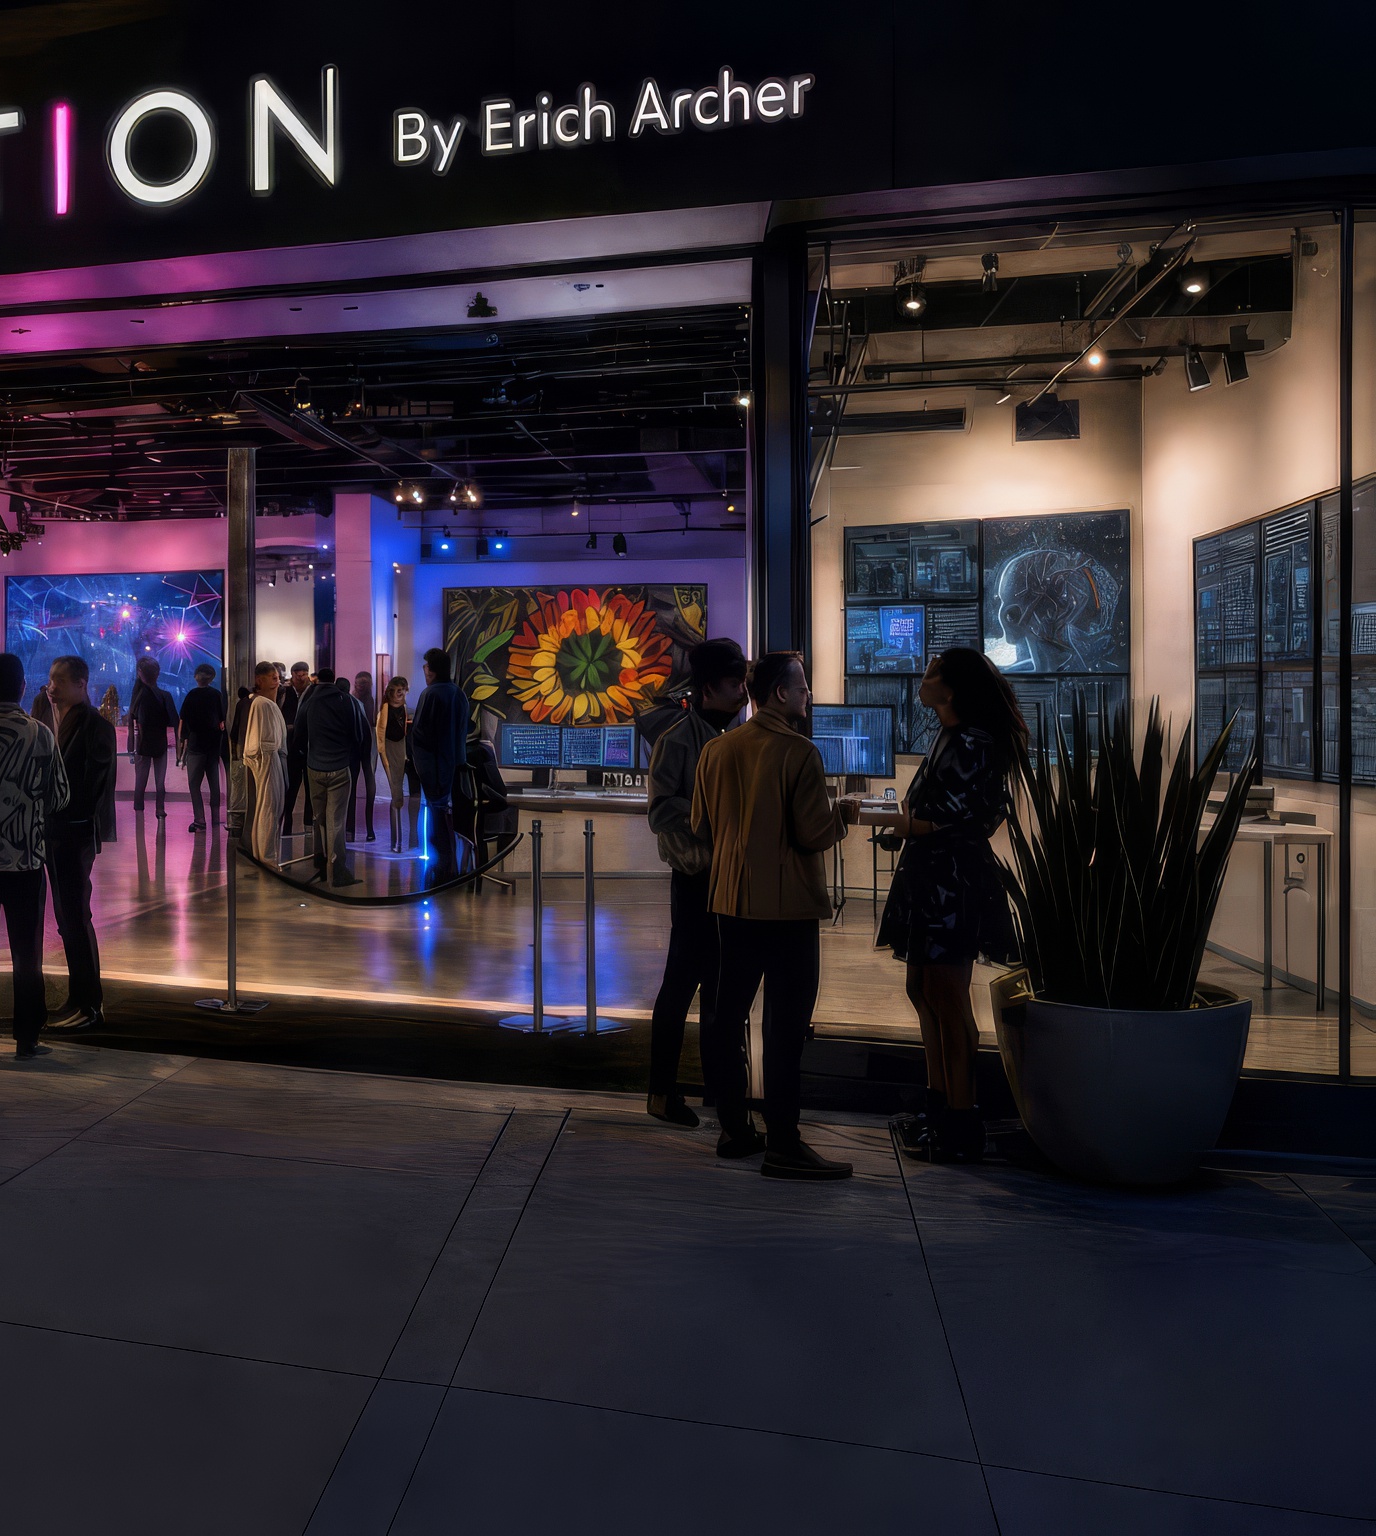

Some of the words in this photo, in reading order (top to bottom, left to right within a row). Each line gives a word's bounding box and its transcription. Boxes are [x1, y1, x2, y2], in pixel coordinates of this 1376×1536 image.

[396, 113, 465, 172] By
[484, 86, 613, 151] Erich
[632, 67, 812, 137] Archer
